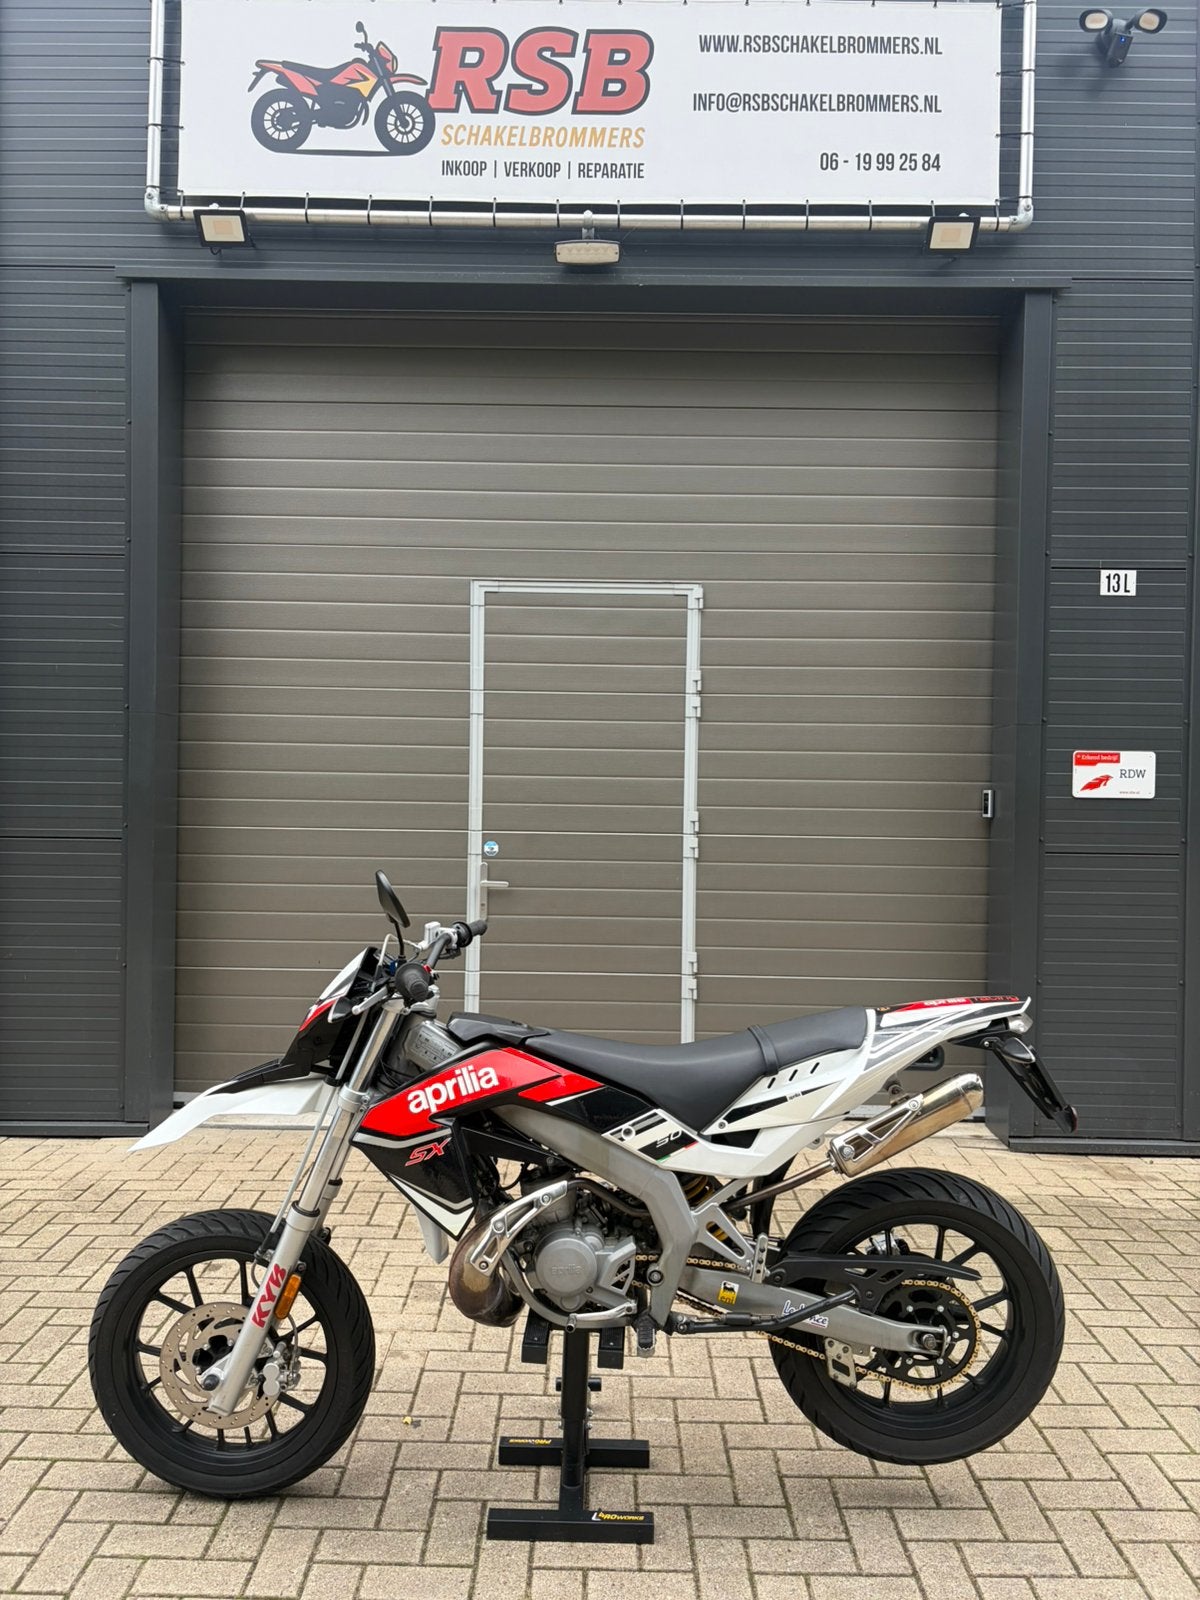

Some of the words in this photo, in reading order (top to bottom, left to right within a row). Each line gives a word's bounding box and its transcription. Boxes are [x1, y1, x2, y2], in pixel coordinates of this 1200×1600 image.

[698, 34, 943, 55] WWW.RSBSCHAKELBROMMERS.NL
[426, 26, 654, 116] RSB
[692, 92, 942, 113] INFO@RSBSCHAKELBROMMERS.NL
[440, 123, 645, 149] SCHAKELBROMMERS
[441, 160, 487, 177] INKOOP
[504, 161, 561, 179] VERKOOP
[577, 162, 645, 179] REPARATIE
[819, 152, 839, 171] 06
[855, 153, 872, 172] 19
[875, 153, 895, 172] 99
[898, 153, 918, 172] 25
[921, 153, 941, 172] 84
[1105, 573, 1121, 593] 13
[1123, 573, 1131, 593] L
[1119, 768, 1146, 779] RDW
[407, 1065, 499, 1114] aprilia
[655, 1129, 682, 1148] 50
[404, 1137, 452, 1167] SX
[250, 1263, 287, 1329] KYB
